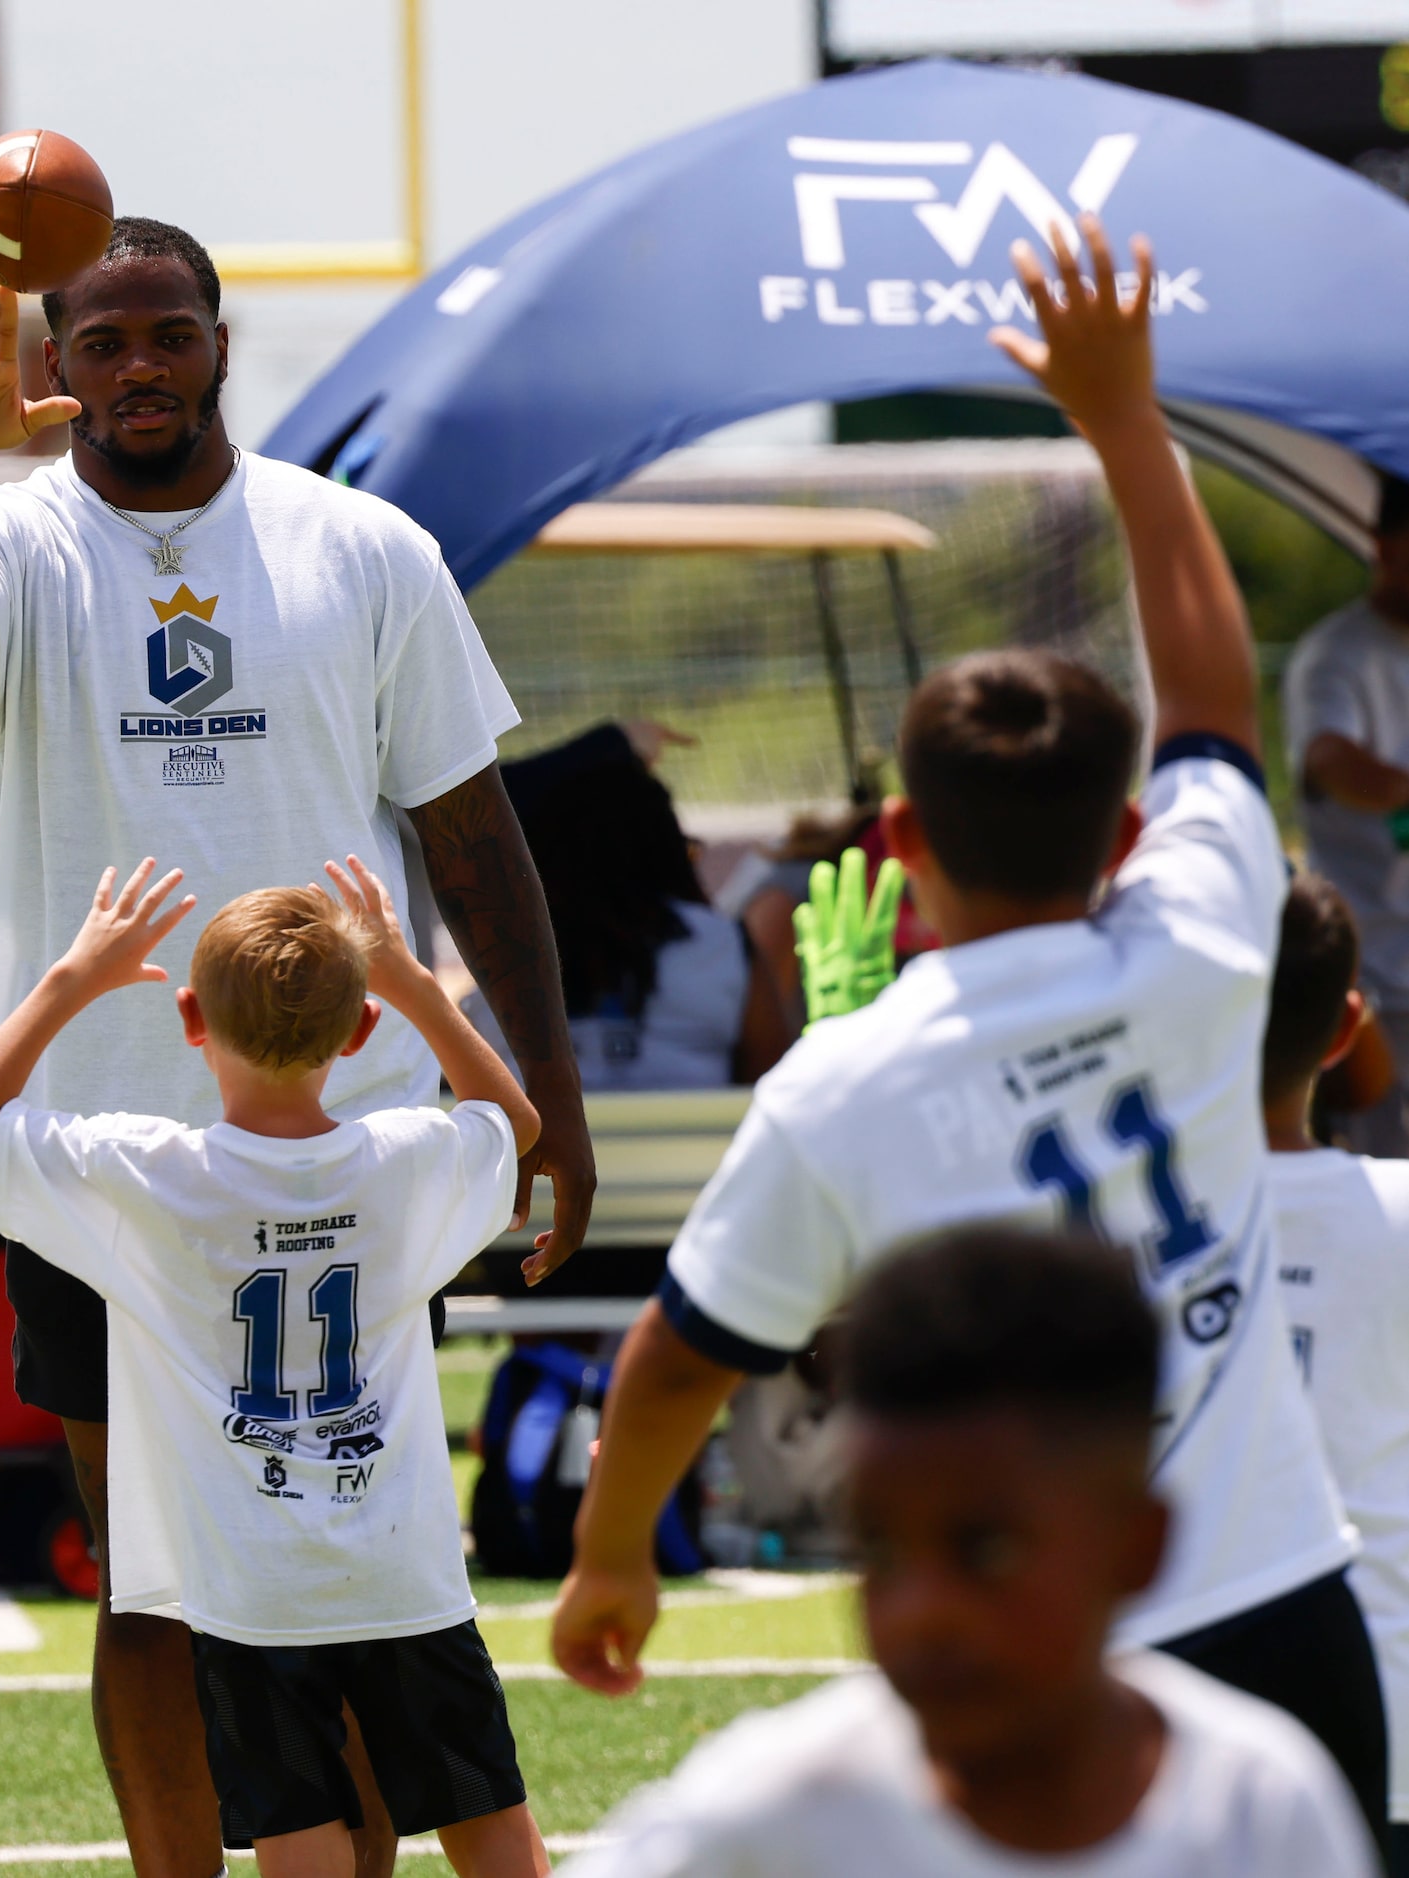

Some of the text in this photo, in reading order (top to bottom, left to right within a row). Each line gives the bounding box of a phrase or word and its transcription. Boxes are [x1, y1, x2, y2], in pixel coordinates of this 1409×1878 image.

[120, 714, 266, 736] LIONS DEN
[162, 761, 224, 771] EXECUTIVE
[275, 1214, 356, 1235] TOM DRAKE
[275, 1236, 335, 1252] ROOFING
[231, 1262, 367, 1421] 11
[331, 1495, 362, 1504] FLEX
